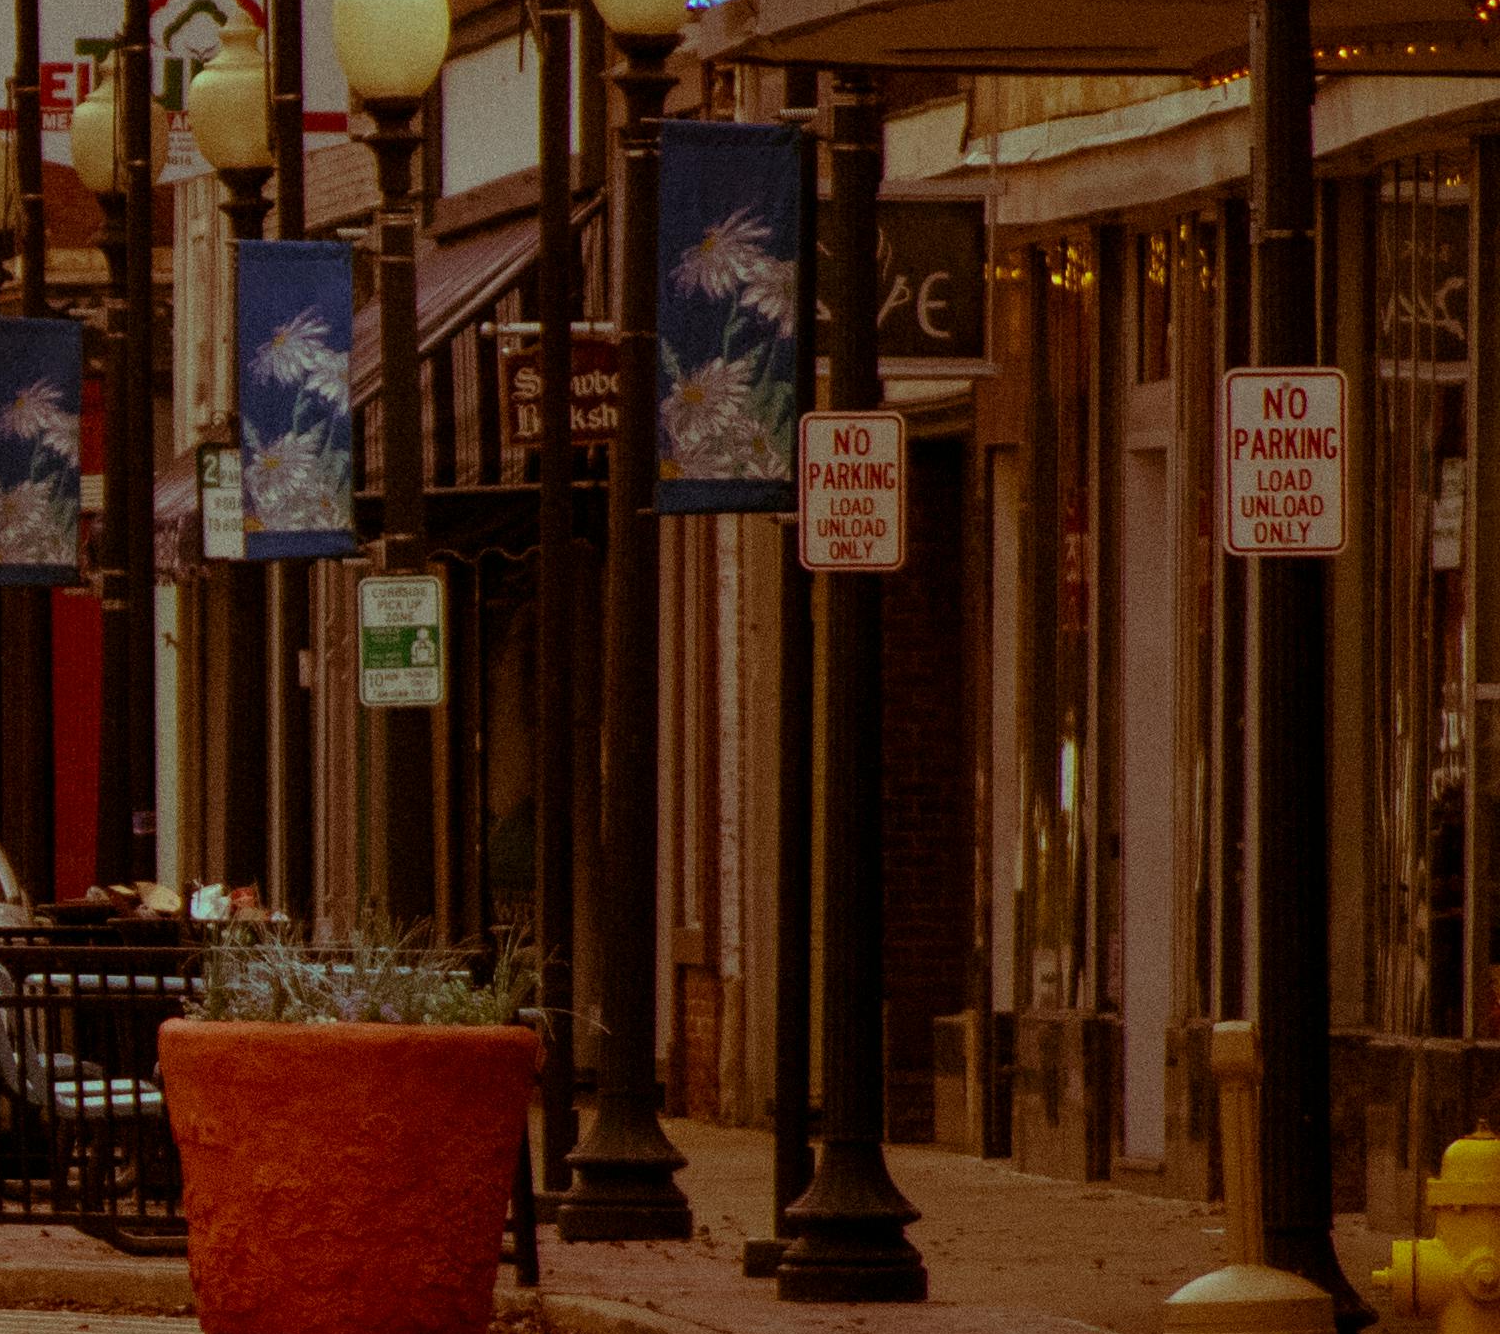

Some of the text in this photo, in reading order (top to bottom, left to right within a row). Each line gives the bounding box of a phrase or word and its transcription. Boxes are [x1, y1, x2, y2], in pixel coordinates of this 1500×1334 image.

[1264, 388, 1307, 419] NO
[834, 428, 870, 455] NO
[1234, 428, 1337, 460] PARKING
[203, 454, 217, 482] 2
[808, 463, 895, 490] PARKING
[1257, 469, 1312, 492] LOAD
[830, 497, 874, 516] LOAD
[1241, 495, 1324, 517] UNLOAD
[817, 519, 886, 537] UNLOAD
[1254, 522, 1310, 543] ONLY
[829, 541, 873, 560] ONLY
